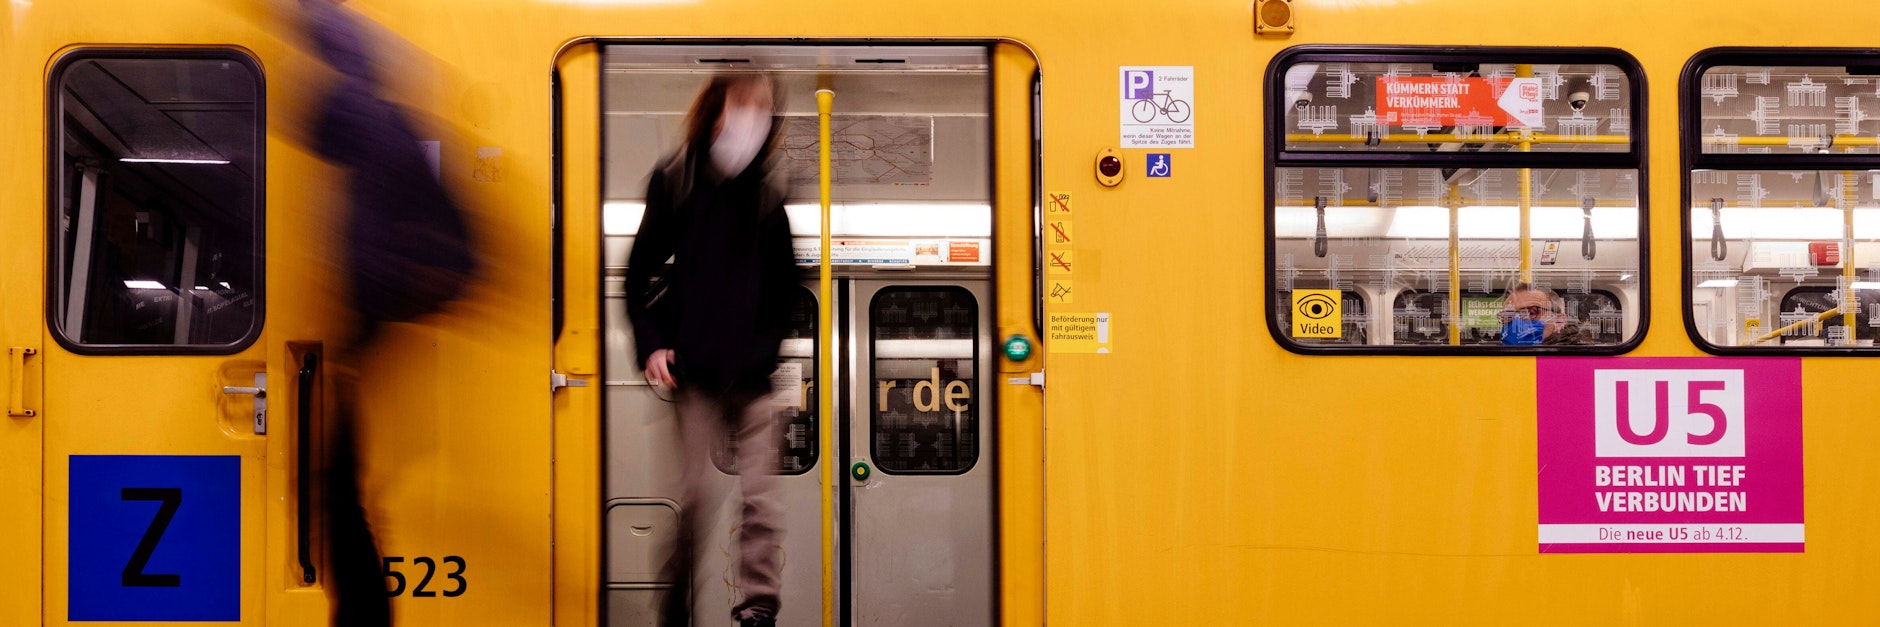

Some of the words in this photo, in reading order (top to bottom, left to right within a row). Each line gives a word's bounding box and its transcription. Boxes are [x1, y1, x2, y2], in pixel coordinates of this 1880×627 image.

[1128, 71, 1150, 99] P
[1386, 81, 1439, 94] KÜMMERN
[1440, 83, 1470, 95] STATT
[1386, 95, 1461, 108] VERKÜMMERN.
[1051, 315, 1095, 324] Beförderung
[1064, 324, 1096, 332] gültigem
[1300, 323, 1334, 334] Video
[913, 367, 970, 412] de
[1595, 465, 1685, 487] BERLIN
[1693, 465, 1746, 487] TIEF
[1595, 491, 1747, 512] VERBUNDEN
[121, 488, 182, 587] Z
[1599, 527, 1621, 540] Die
[1627, 529, 1663, 540] neue
[1669, 527, 1688, 540] U5
[1694, 527, 1711, 540] ab
[1716, 527, 1748, 540] 4.12.
